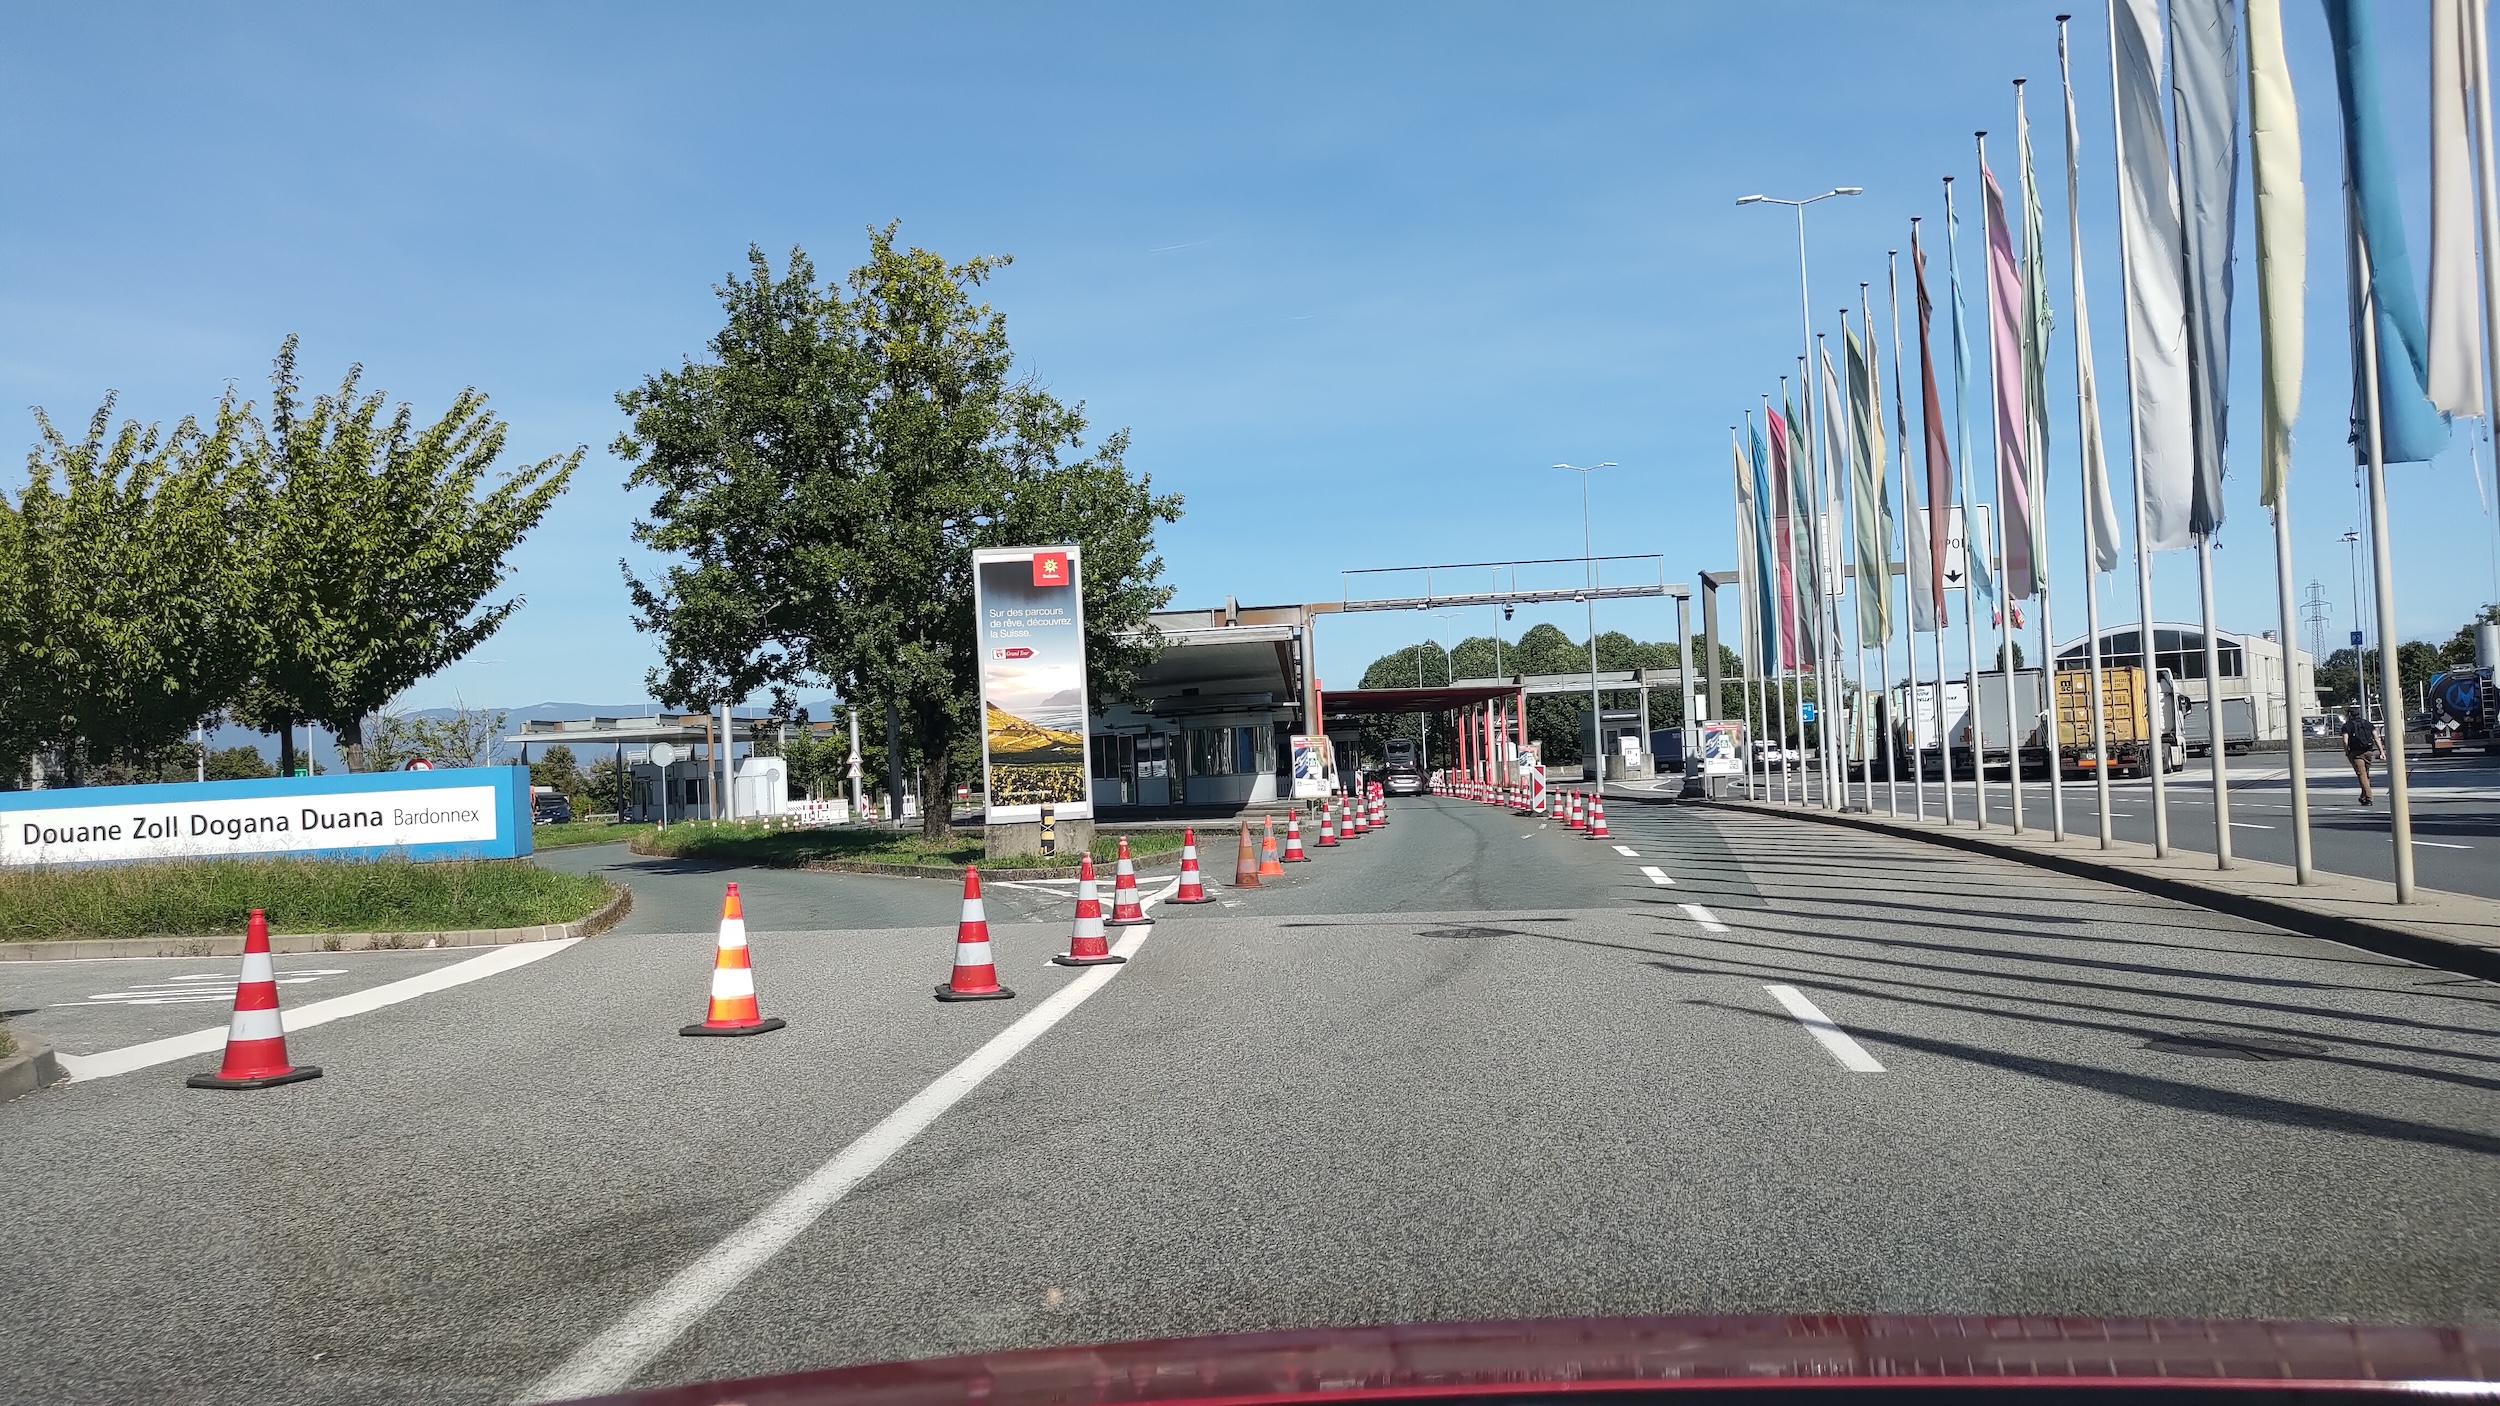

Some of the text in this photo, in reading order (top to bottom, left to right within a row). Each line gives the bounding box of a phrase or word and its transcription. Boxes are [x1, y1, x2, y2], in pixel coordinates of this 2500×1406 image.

[989, 608, 1064, 618] Sur des parcours
[989, 617, 1072, 628] de rêve, découvrez
[990, 629, 1032, 639] la Suisse.
[24, 807, 480, 845] Douane Zoll Dogana Duana Bardonnex
